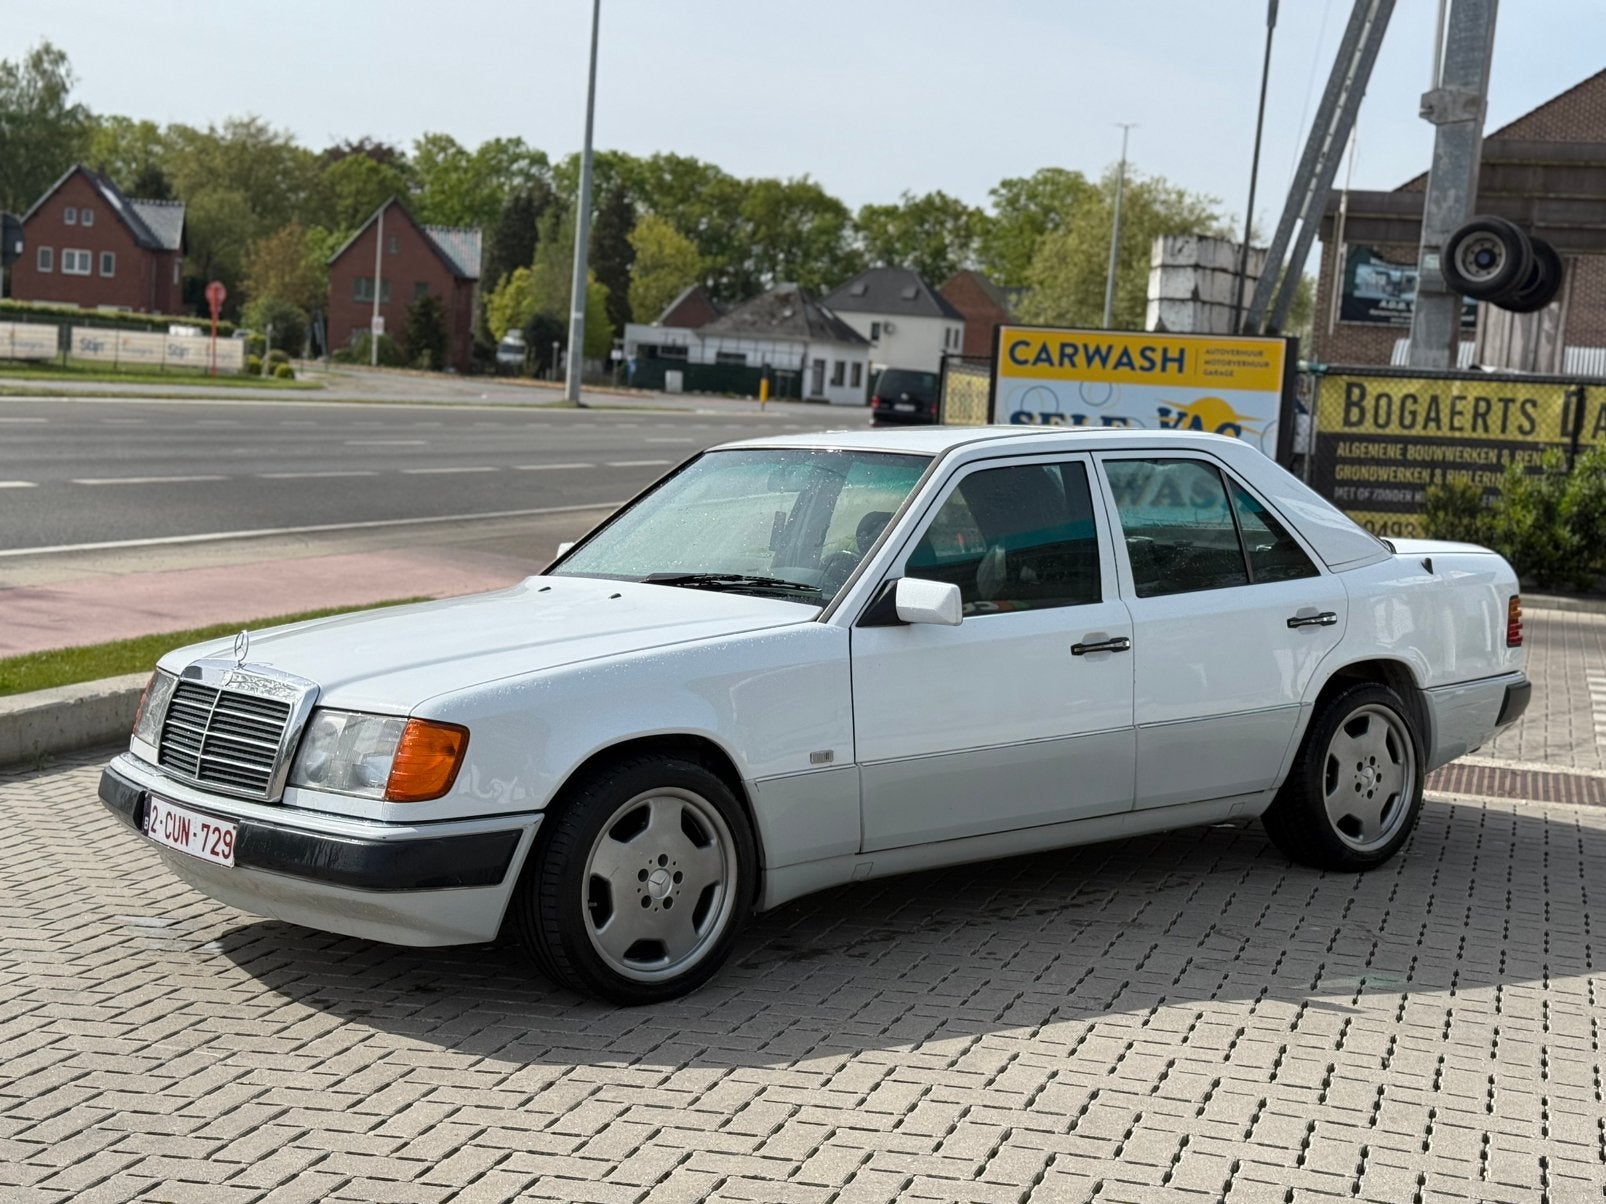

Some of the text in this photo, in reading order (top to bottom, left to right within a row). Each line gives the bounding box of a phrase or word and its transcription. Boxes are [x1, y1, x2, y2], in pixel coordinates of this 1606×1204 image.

[1008, 339, 1187, 374] CARWASH
[1203, 369, 1235, 377] GARAGE
[1342, 382, 1538, 437] BOGAERTS
[1336, 441, 1404, 460] ALGEMENE
[1406, 444, 1498, 465] BOUWWERKEN
[1501, 448, 1510, 465] &
[1334, 463, 1431, 484] GRONDWERKEN
[1433, 467, 1442, 485] &
